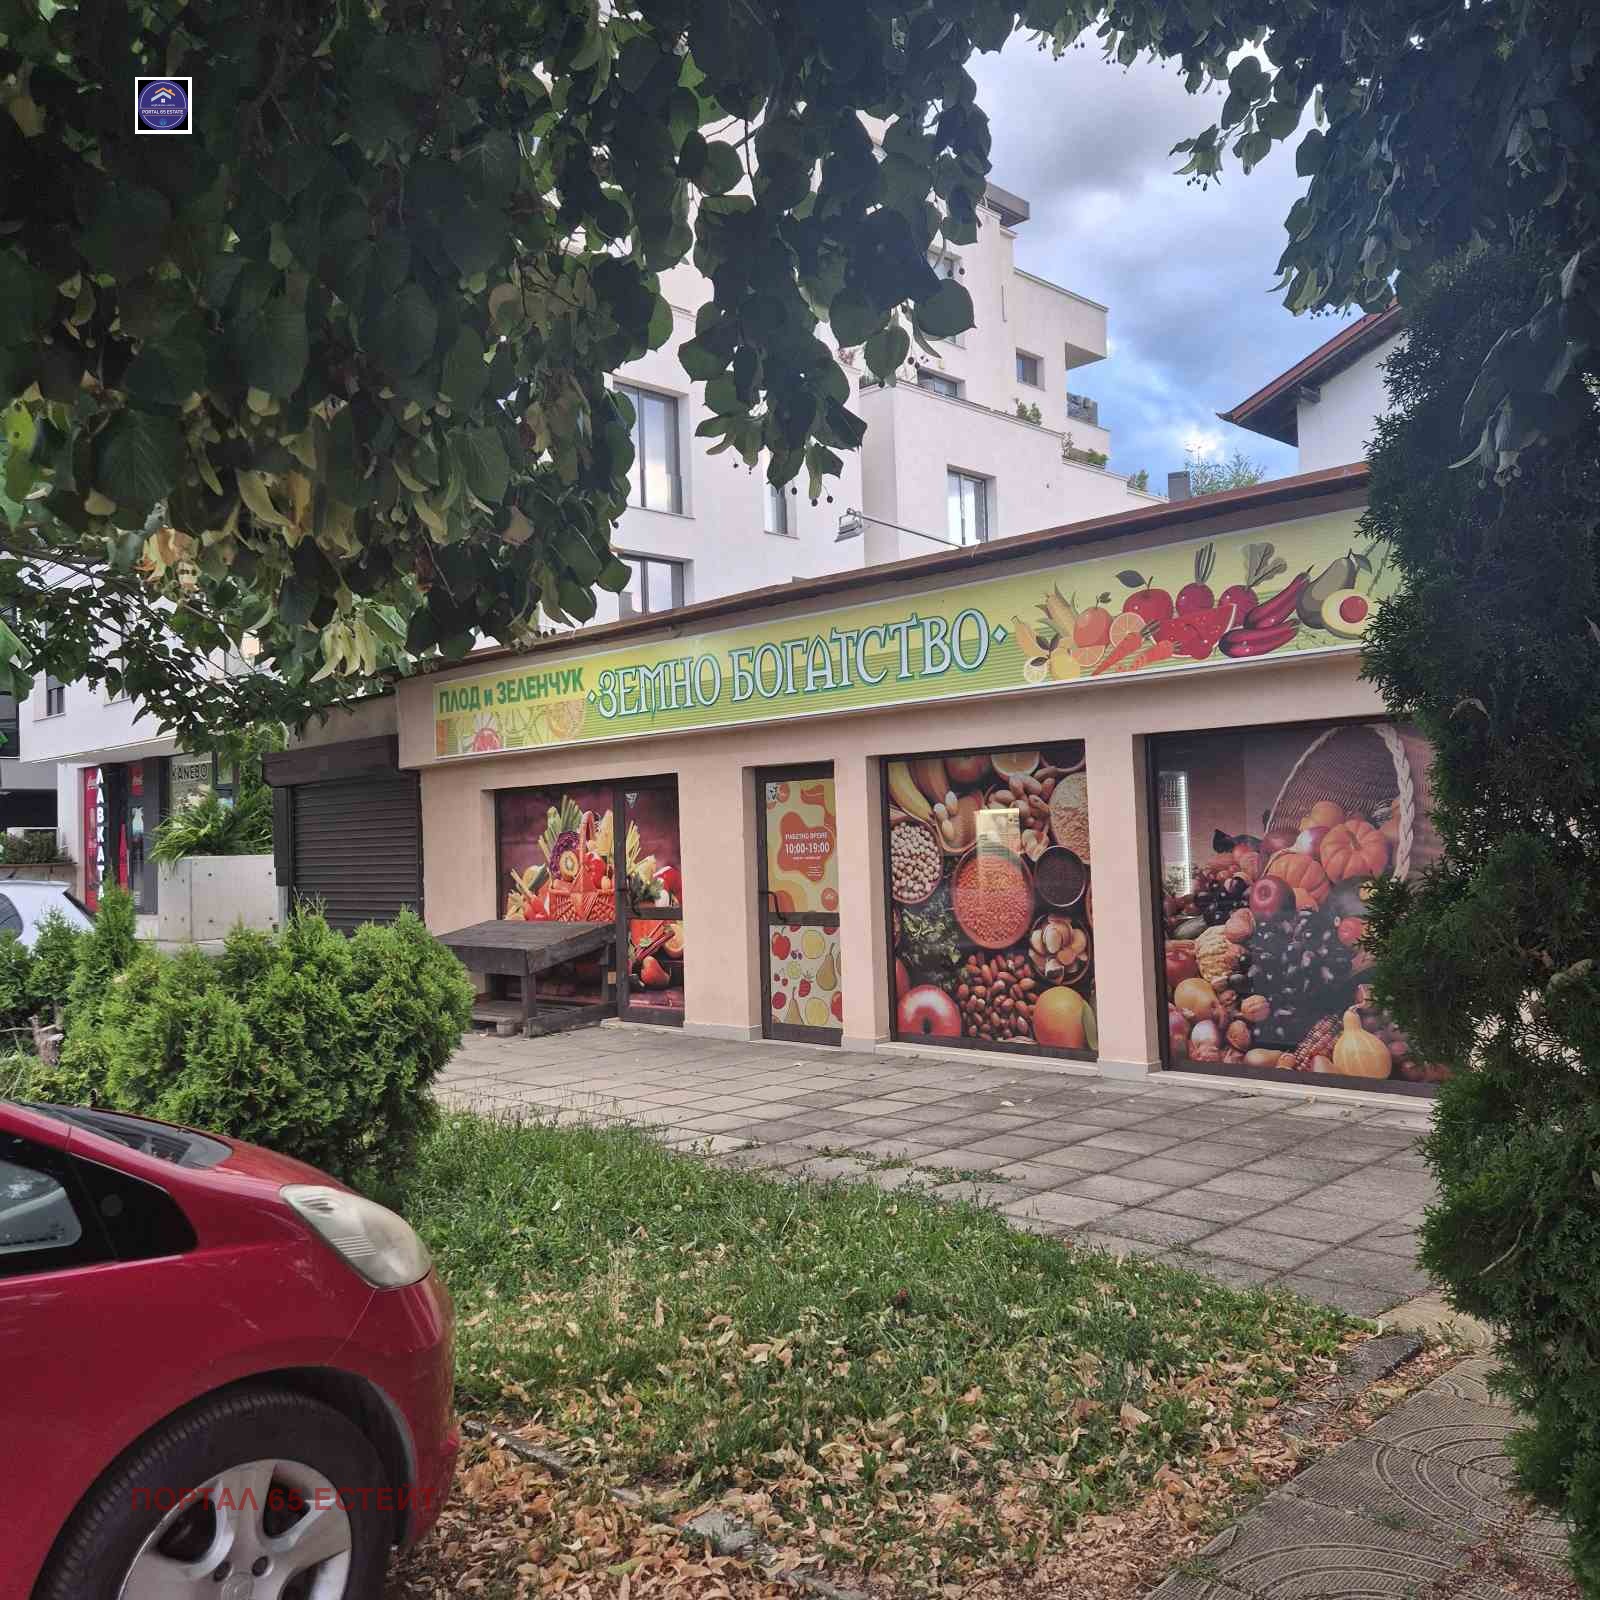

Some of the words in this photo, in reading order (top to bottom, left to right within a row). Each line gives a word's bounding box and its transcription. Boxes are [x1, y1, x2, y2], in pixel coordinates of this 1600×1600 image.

[598, 652, 723, 722] ЗЕМНО
[729, 607, 990, 702] БОГАТСТВО
[439, 686, 481, 713] ПЛОД
[496, 667, 584, 704] ЗЕЛЕНЧУК
[785, 842, 830, 855] 10:00-19:00
